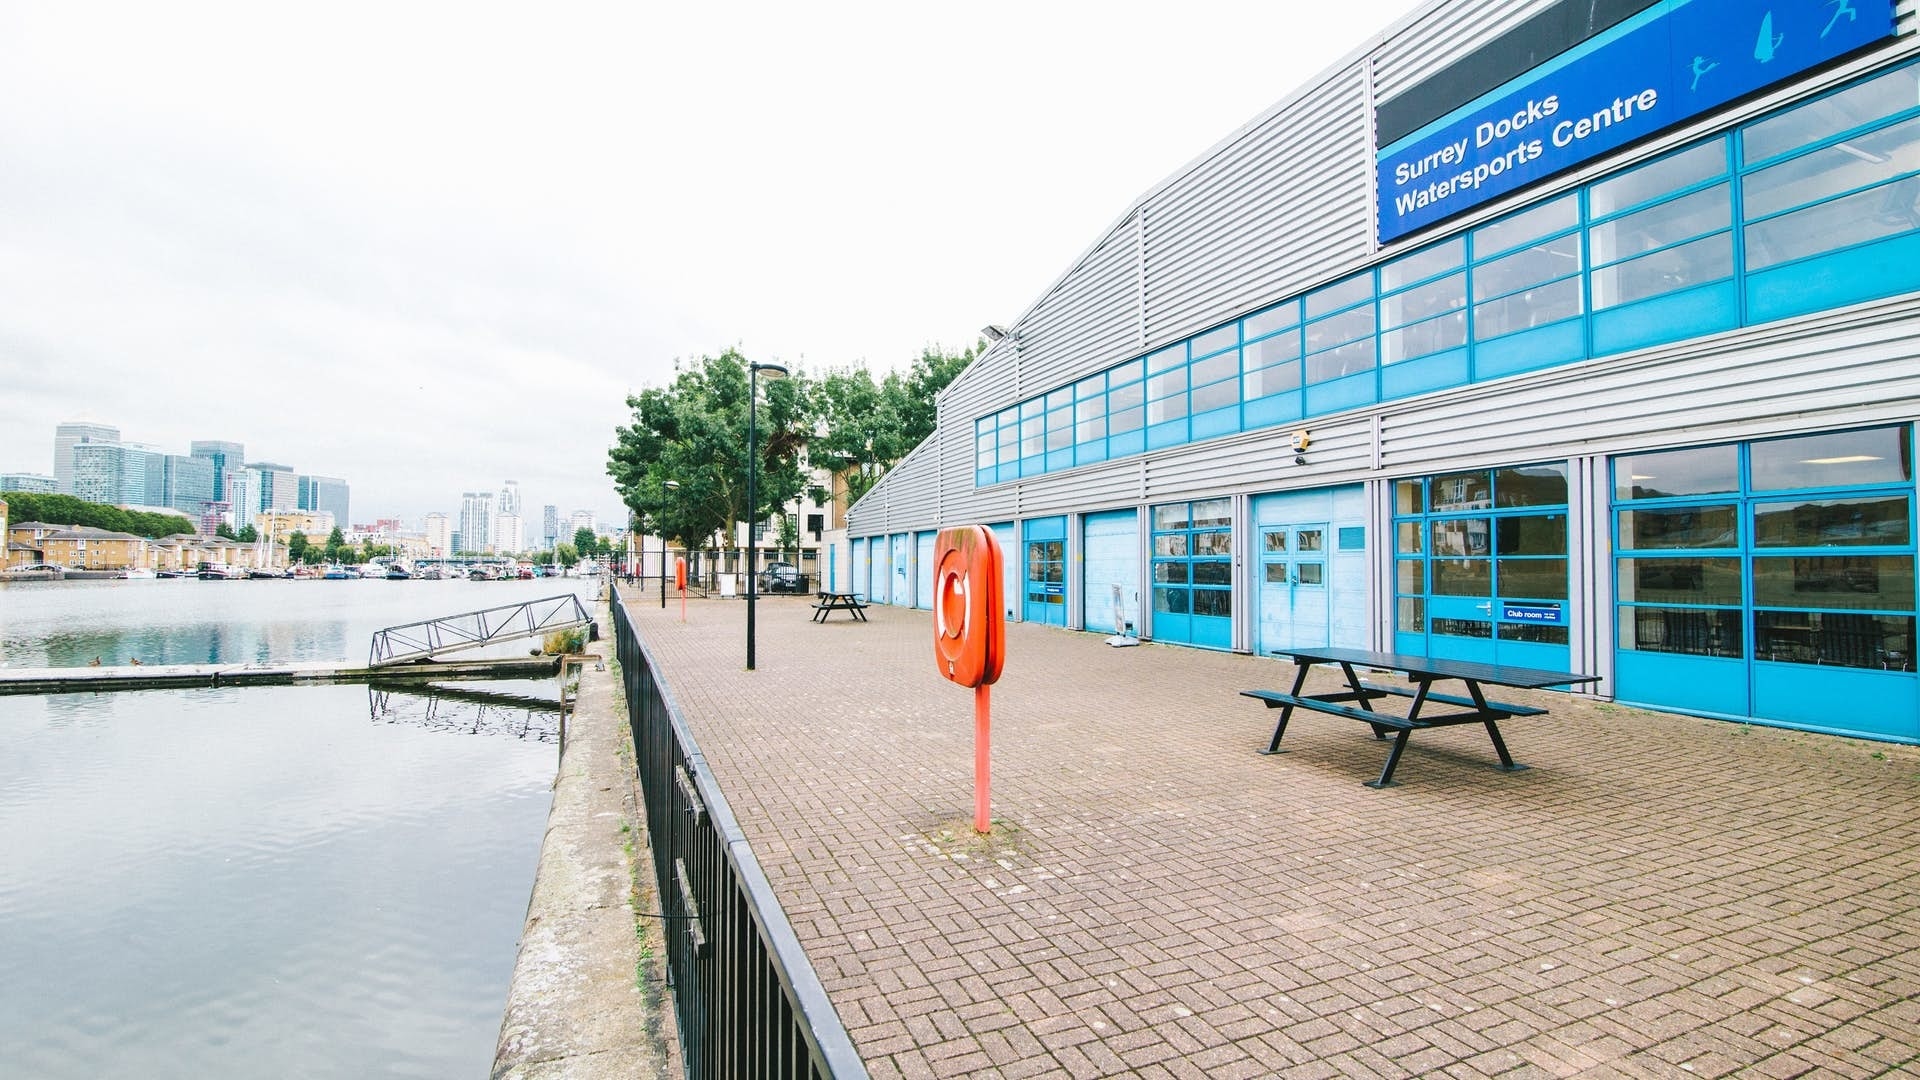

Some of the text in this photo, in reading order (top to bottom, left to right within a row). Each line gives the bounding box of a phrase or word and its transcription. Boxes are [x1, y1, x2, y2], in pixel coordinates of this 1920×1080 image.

[1395, 95, 1559, 185] Surrey Docks
[1395, 88, 1657, 216] Watersports Centre
[1524, 611, 1542, 619] room
